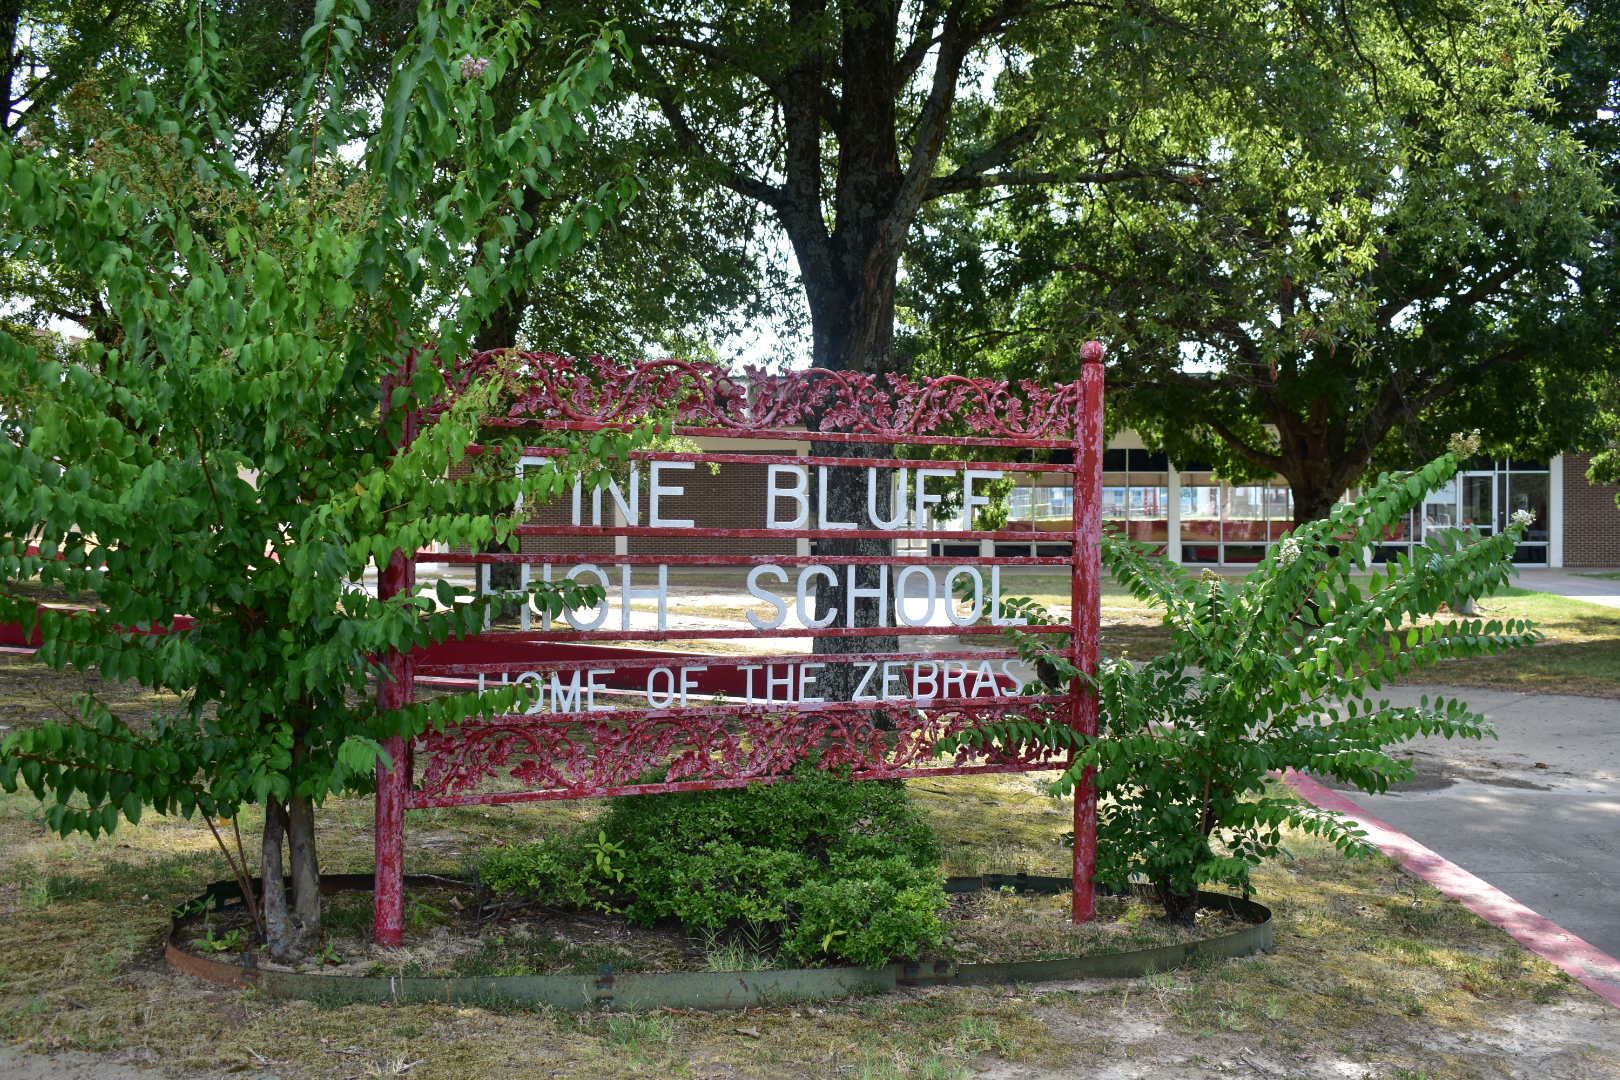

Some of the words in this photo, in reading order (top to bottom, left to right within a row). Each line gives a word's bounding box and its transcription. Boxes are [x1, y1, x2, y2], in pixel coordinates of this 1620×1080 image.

[766, 464, 1003, 531] BLUFF
[746, 564, 1027, 629] SCHOOL
[647, 666, 708, 709] OF
[737, 663, 825, 704] THE
[852, 659, 1025, 701] ZEBRAS
